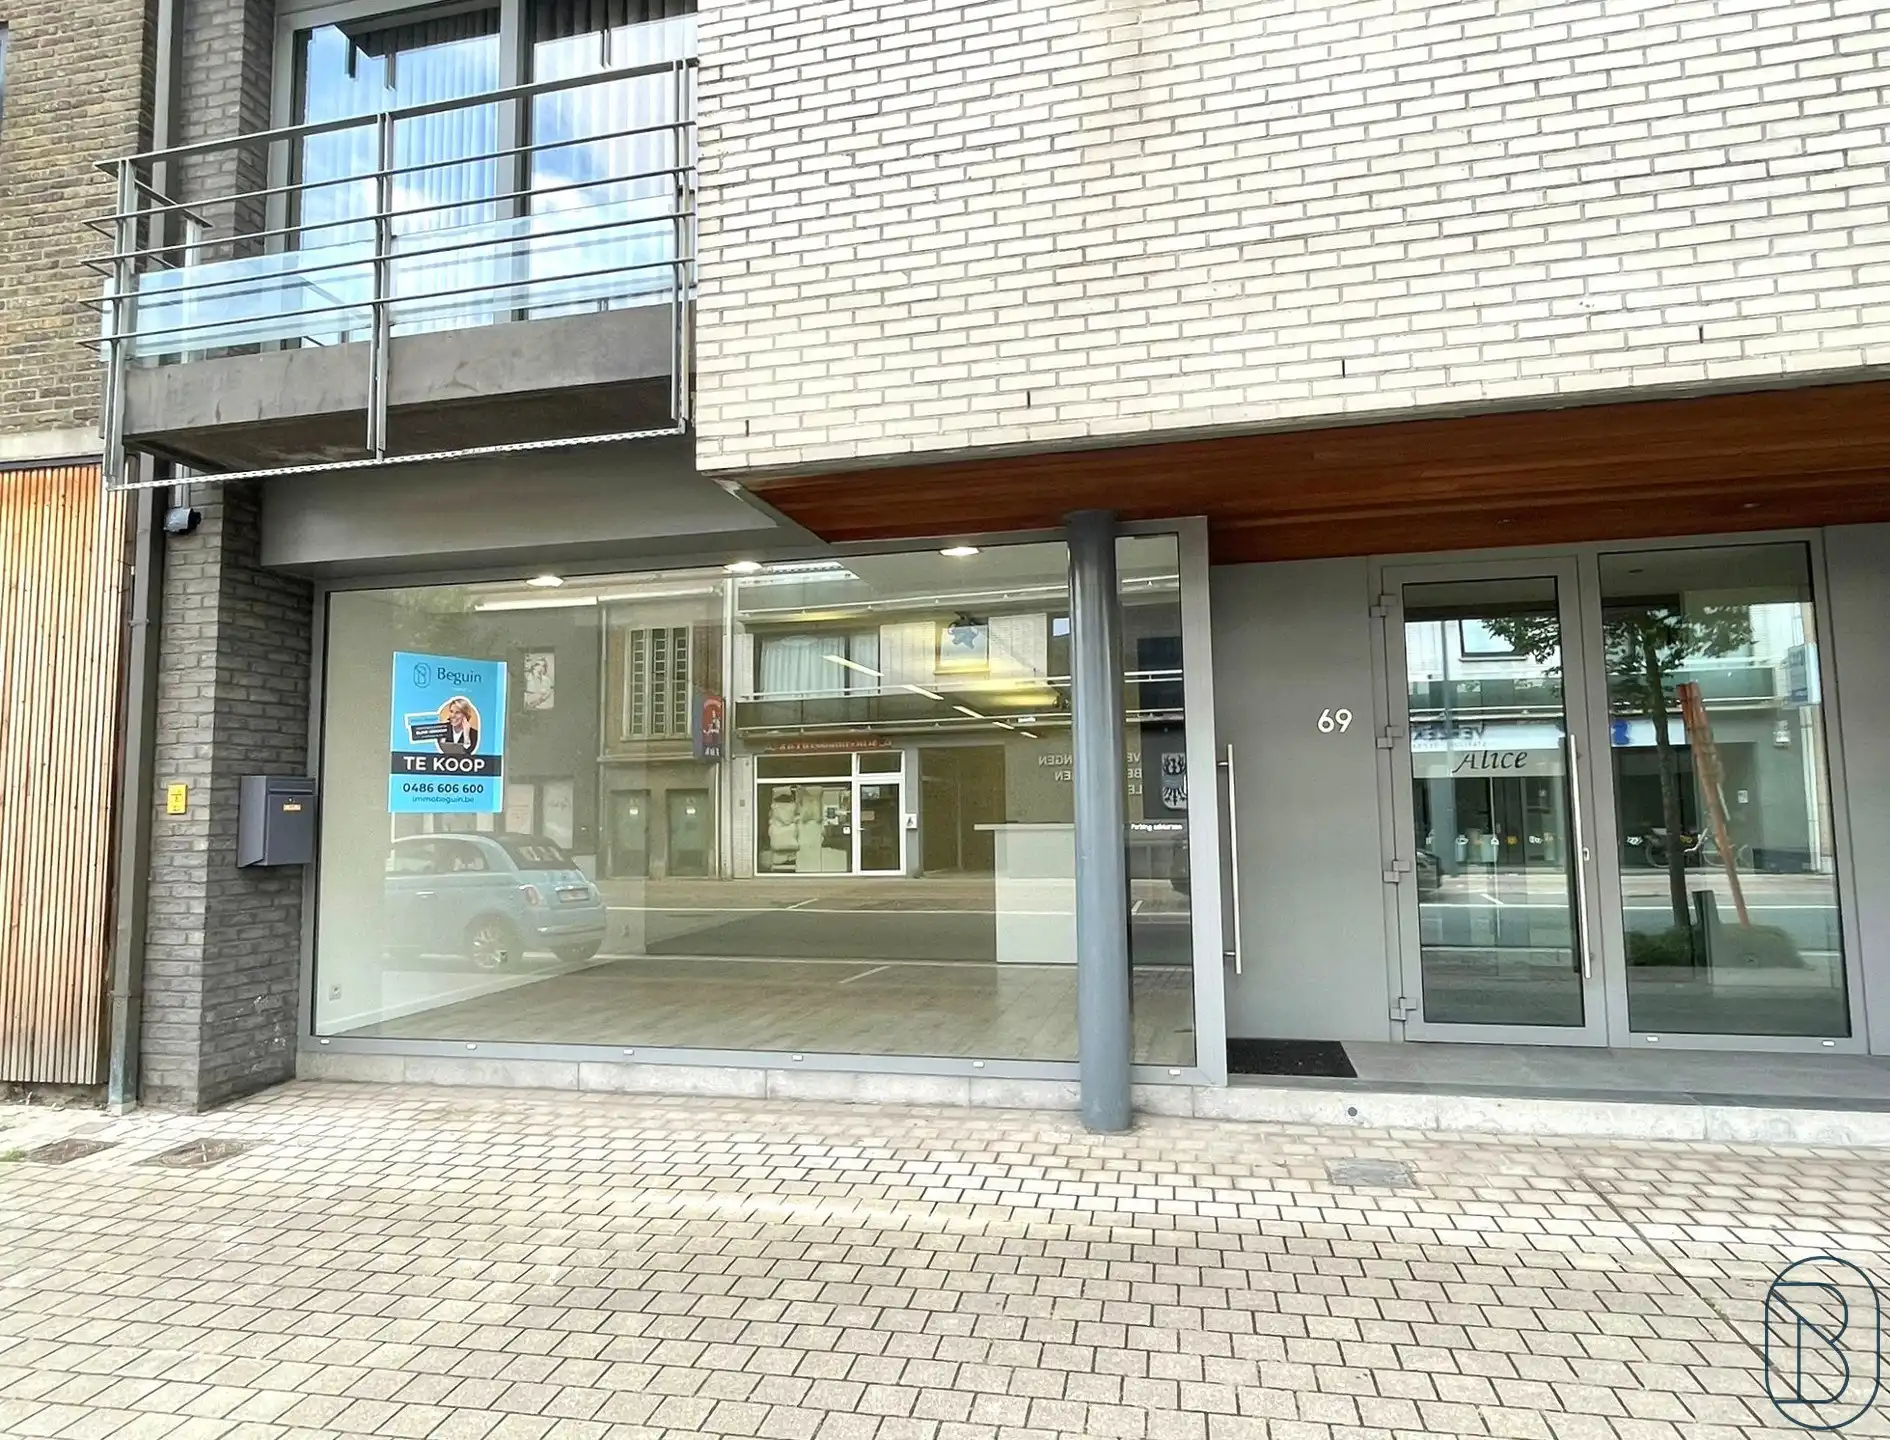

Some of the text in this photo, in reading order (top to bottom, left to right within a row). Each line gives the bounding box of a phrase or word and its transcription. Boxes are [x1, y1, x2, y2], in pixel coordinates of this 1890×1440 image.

[437, 667, 482, 686] Beguin
[1316, 707, 1353, 733] 69
[403, 756, 485, 773] TE KOOP
[1452, 750, 1528, 774] Alice
[403, 783, 484, 794] 0486 606 600
